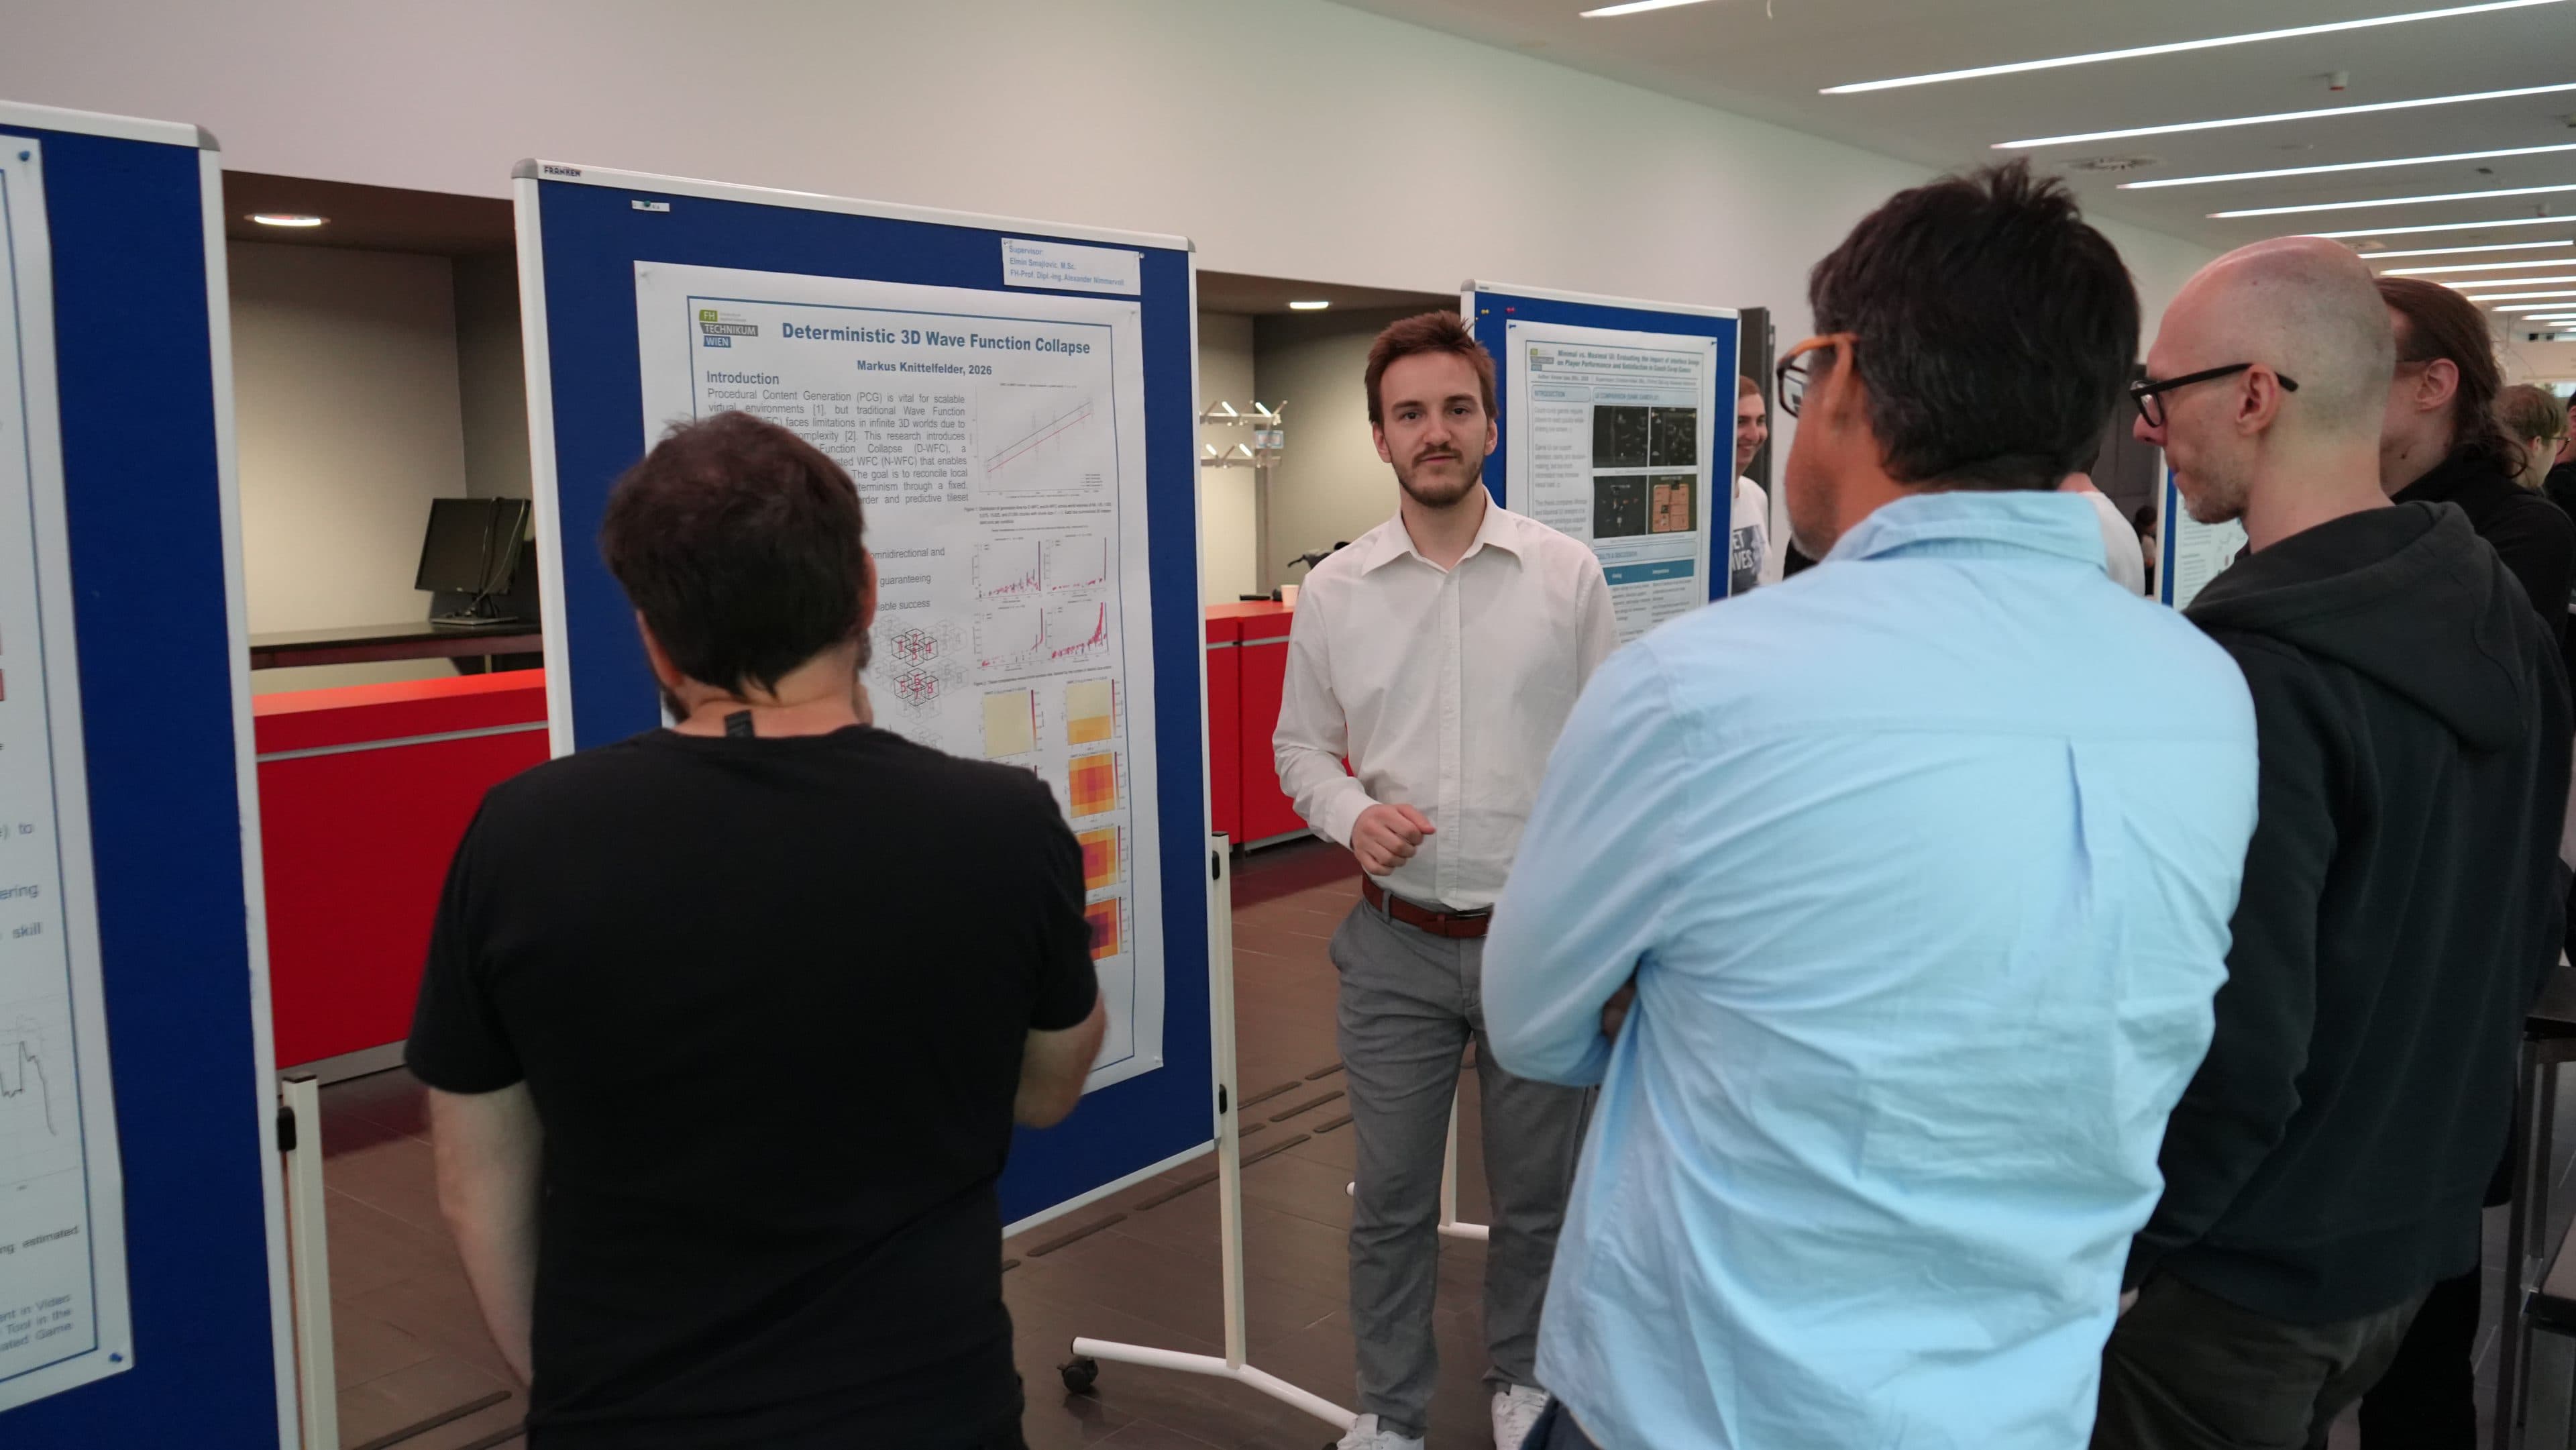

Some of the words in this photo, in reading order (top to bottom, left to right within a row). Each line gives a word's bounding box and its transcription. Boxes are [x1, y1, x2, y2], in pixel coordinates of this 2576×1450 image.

[543, 166, 581, 177] FRANKEN
[1065, 273, 1092, 283] Alexander
[704, 311, 715, 321] FH
[704, 324, 756, 335] TECHNIKUM
[706, 337, 729, 346] WIEN
[782, 322, 896, 344] Deterministic
[901, 329, 921, 345] 3D
[926, 331, 965, 348] Wave
[971, 333, 1031, 350] Function
[1036, 338, 1090, 356] Collapse
[857, 360, 896, 371] Markus
[900, 362, 966, 376] Knittelfelder,
[969, 364, 992, 375] 2026
[707, 370, 780, 385] Introduction
[708, 388, 757, 399] Procedural
[763, 389, 798, 400] Content
[803, 391, 851, 402] Generation
[857, 392, 882, 403] (PCG)
[887, 393, 894, 403] is
[898, 393, 914, 403] vital
[919, 394, 929, 403] for
[934, 394, 965, 404] scalable
[708, 403, 736, 413] virtual
[745, 403, 804, 413] environments
[835, 405, 849, 415] but
[857, 406, 896, 415] traditional
[904, 406, 926, 416] Wave
[932, 407, 965, 416] Function
[786, 417, 809, 427] faces
[813, 417, 855, 427] limitations
[859, 419, 866, 427] in
[869, 419, 895, 427] infinite
[898, 419, 910, 428] 3D
[913, 419, 938, 428] worlds
[941, 419, 955, 428] due
[957, 420, 965, 428] to
[864, 431, 881, 440] This
[887, 431, 921, 441] research
[926, 431, 965, 441] introduces
[820, 444, 855, 454] Function
[868, 444, 902, 455] Collapse
[857, 456, 878, 466] WFC
[881, 456, 917, 467] (N-WFC)
[920, 457, 934, 466] that
[937, 456, 967, 466] enables
[851, 470, 867, 478] The
[871, 470, 889, 480] goal
[892, 470, 899, 478] is
[902, 470, 910, 478] to
[913, 469, 947, 478] reconcile
[951, 468, 968, 478] local
[859, 482, 898, 492] terminism
[904, 481, 932, 493] through
[885, 494, 900, 504] and
[906, 493, 942, 505] predictive
[947, 493, 969, 502] tileset
[1733, 531, 1745, 550] ET
[930, 548, 945, 557] and
[879, 574, 931, 588] guaranteeing
[900, 600, 930, 610] success
[18, 824, 33, 835] to
[22, 1225, 78, 1248] estimated
